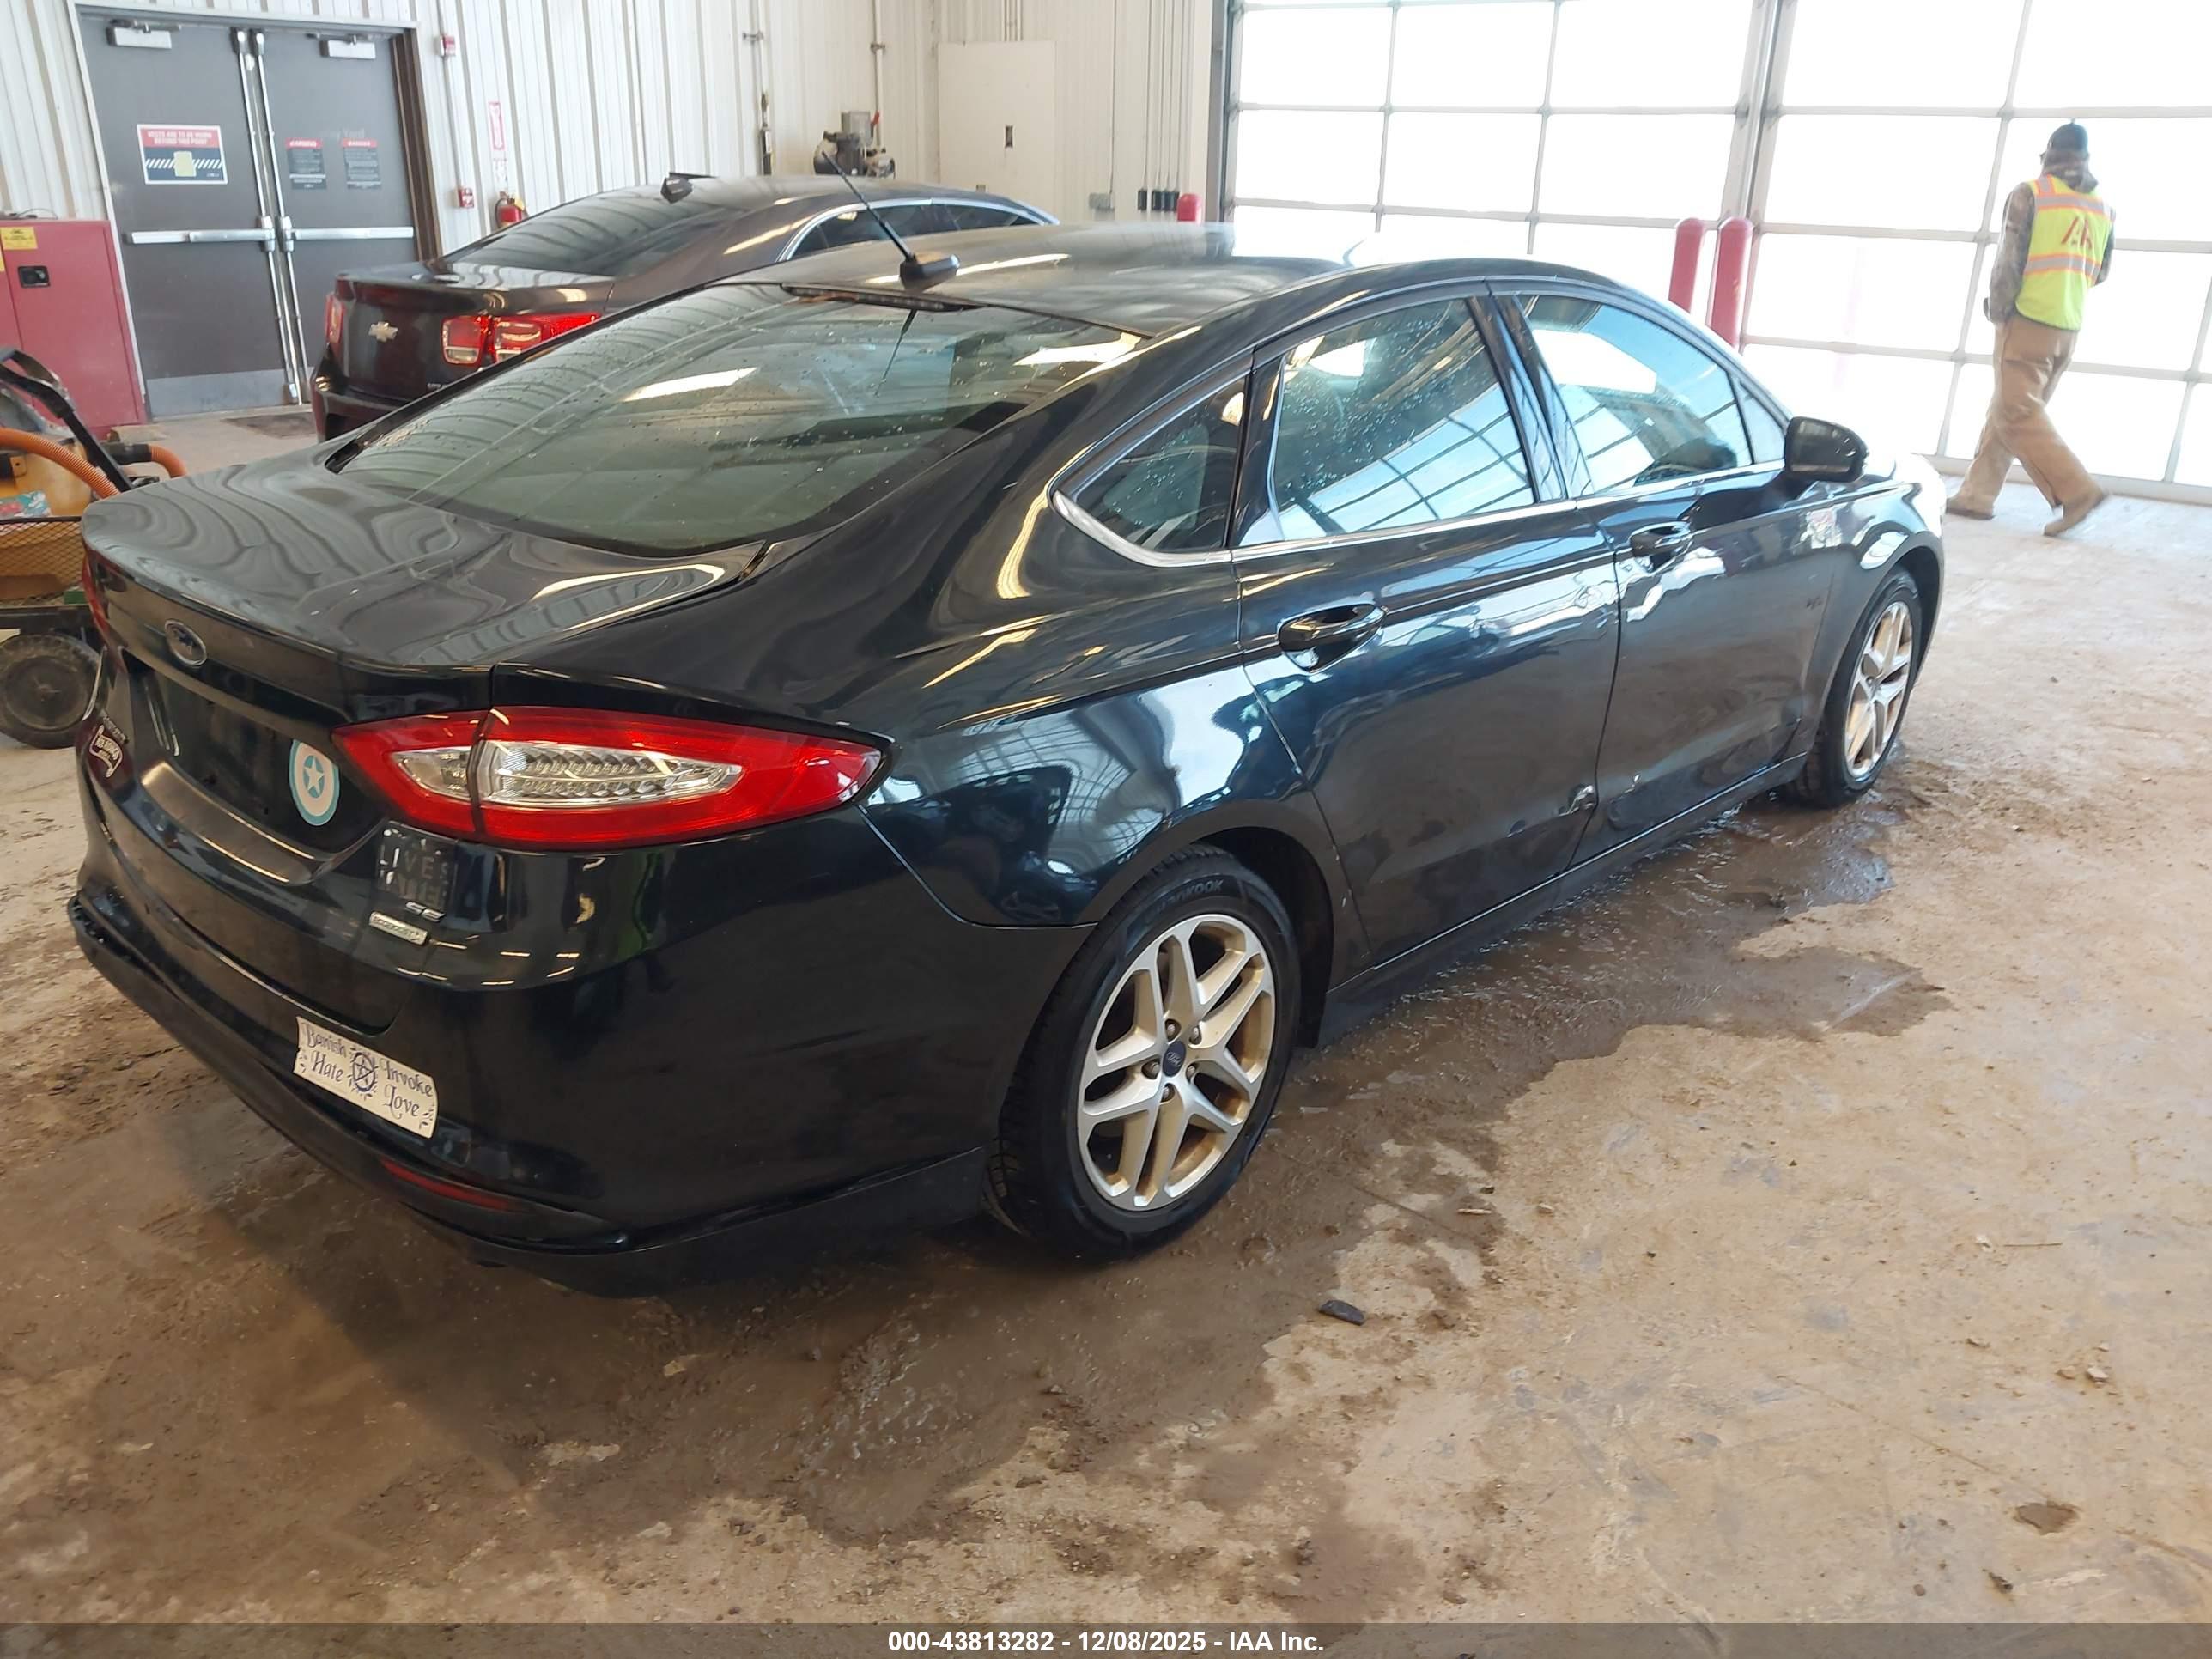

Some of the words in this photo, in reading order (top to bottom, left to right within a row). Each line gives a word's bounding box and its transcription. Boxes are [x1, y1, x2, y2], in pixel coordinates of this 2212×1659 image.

[406, 901, 446, 922] SE
[301, 1022, 347, 1058] Banish
[310, 1050, 344, 1082] Hate
[379, 1058, 433, 1097] Invoke
[384, 1085, 420, 1120] Love
